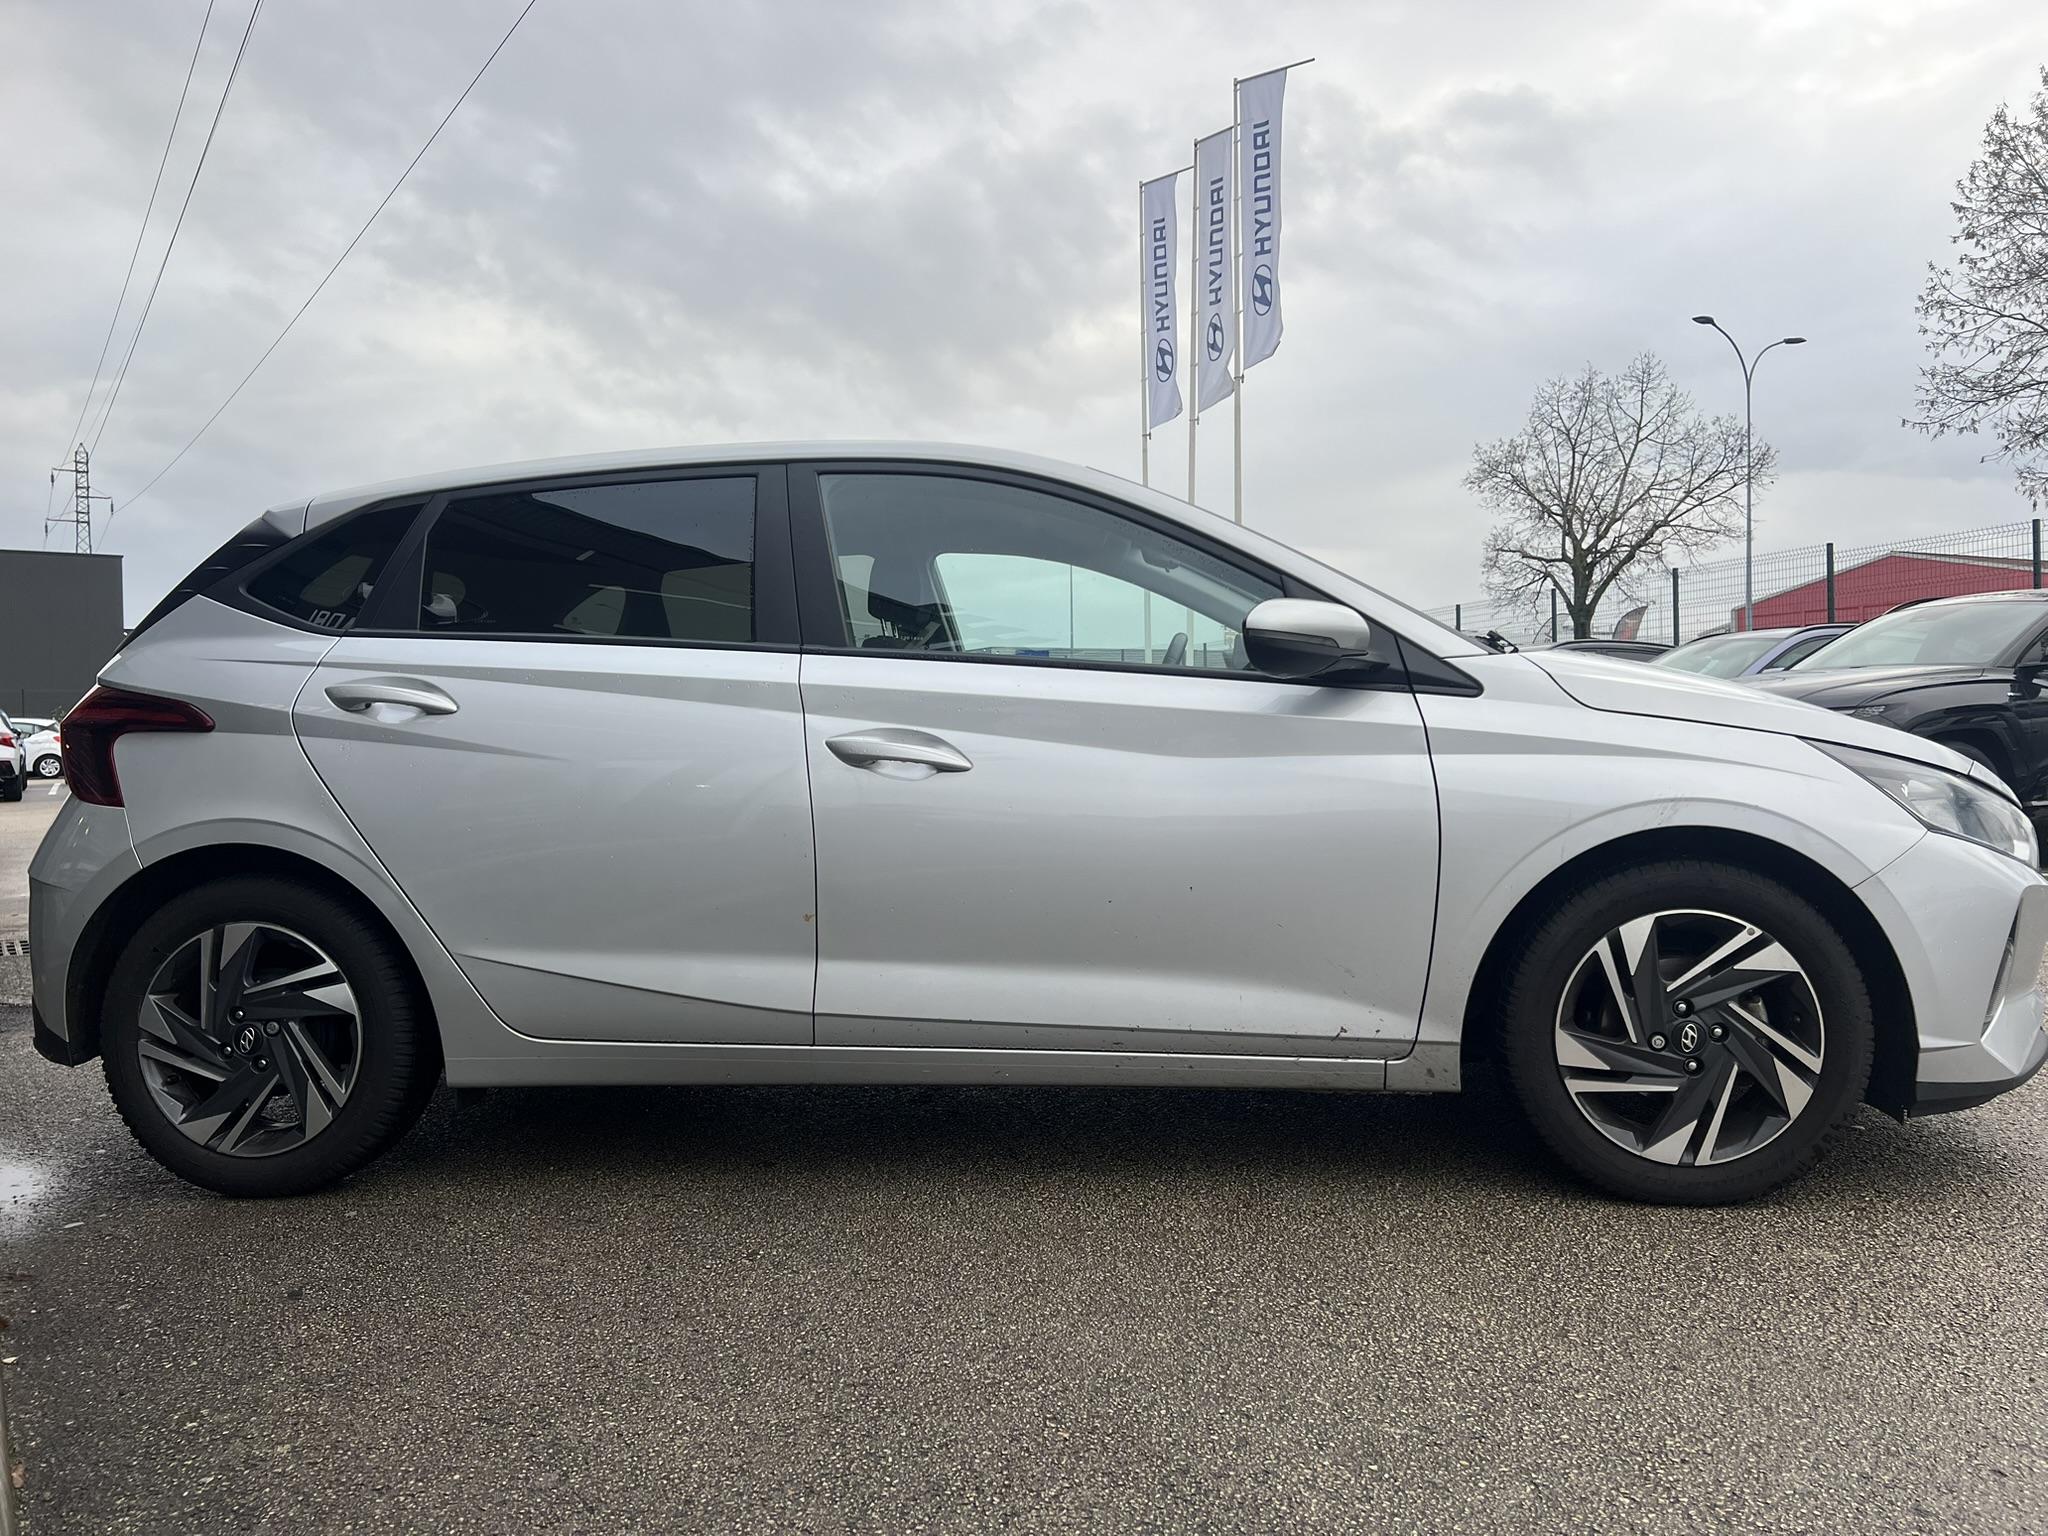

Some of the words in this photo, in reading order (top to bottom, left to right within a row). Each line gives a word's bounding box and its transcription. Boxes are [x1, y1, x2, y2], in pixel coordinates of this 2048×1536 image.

[1209, 176, 1224, 306] HYUNDAI
[1253, 119, 1271, 257] HYUNDAI
[1153, 217, 1170, 333] HYUNDAI
